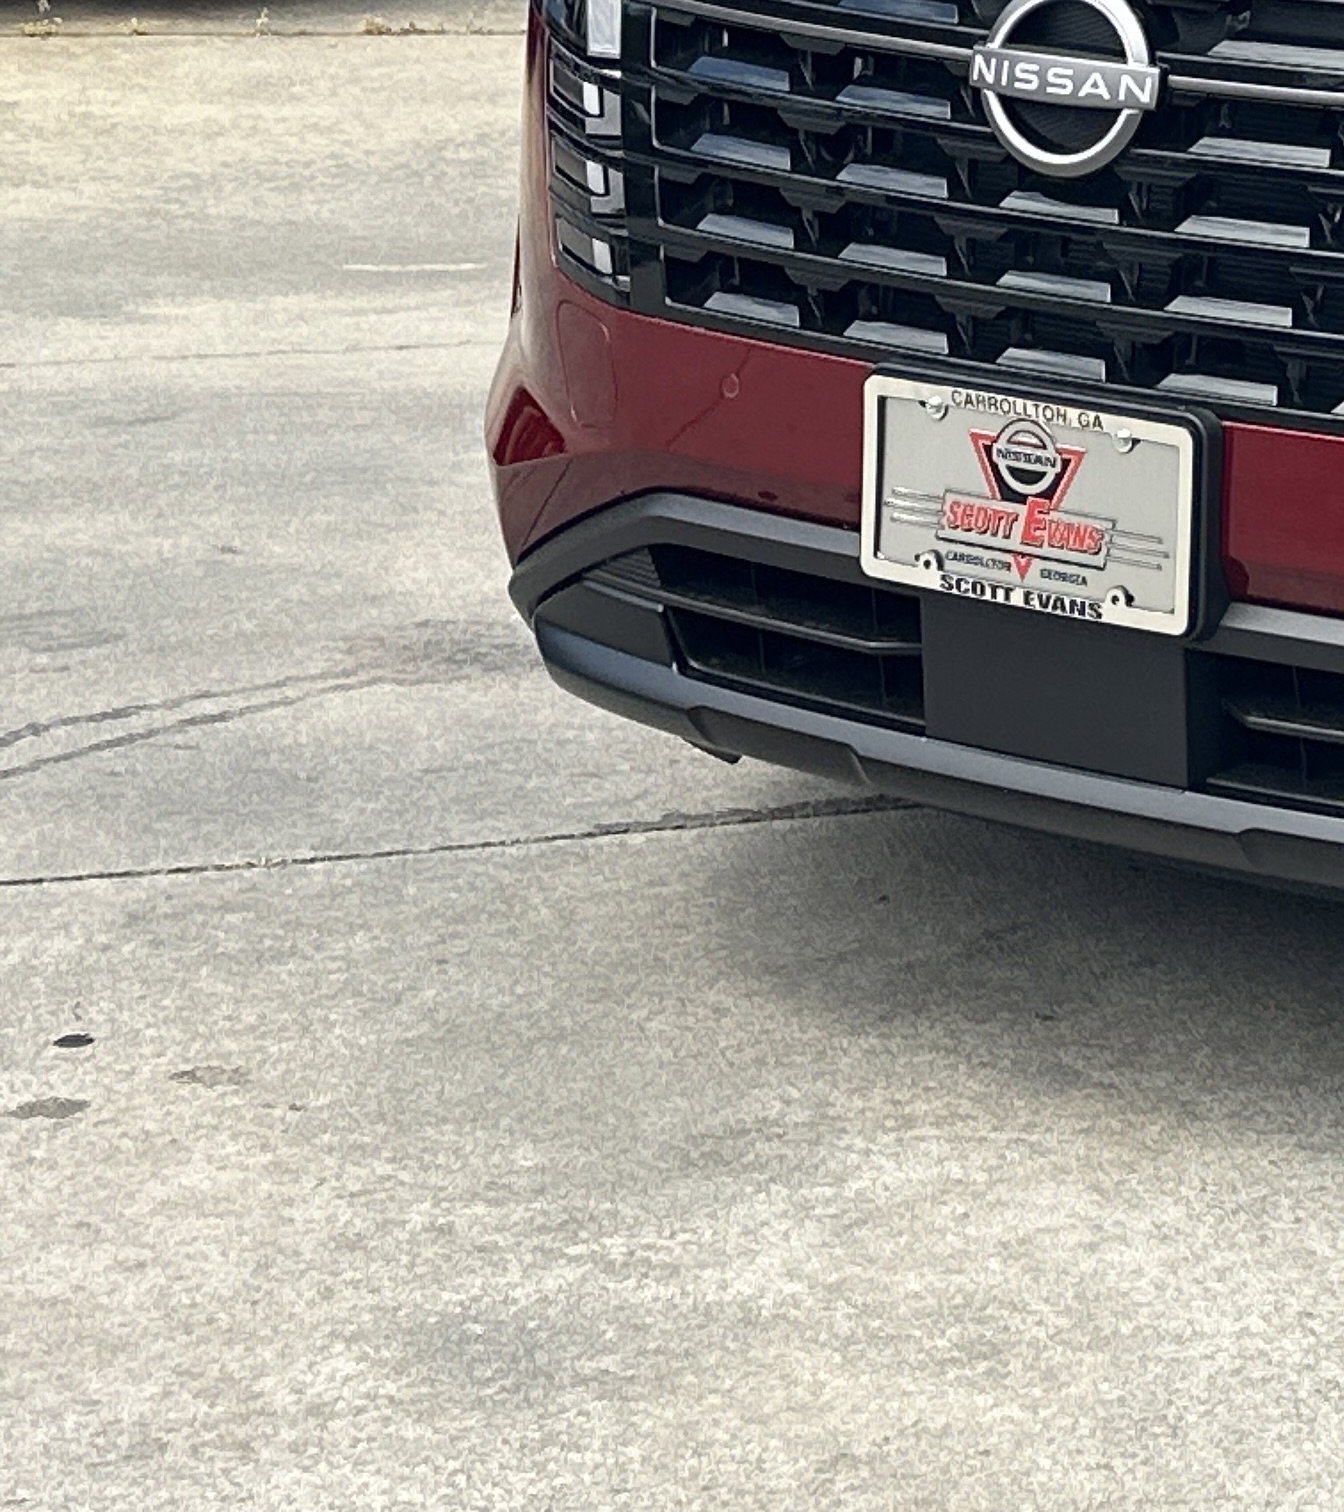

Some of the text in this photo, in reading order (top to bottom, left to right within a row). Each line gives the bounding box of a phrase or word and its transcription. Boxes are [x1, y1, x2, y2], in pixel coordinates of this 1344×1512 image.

[972, 53, 1152, 104] NISSAN
[1077, 411, 1104, 431] GA
[996, 448, 1057, 468] NISSAN
[946, 500, 1020, 540] SCOTT
[939, 573, 1104, 620] SCOTT EVANS
